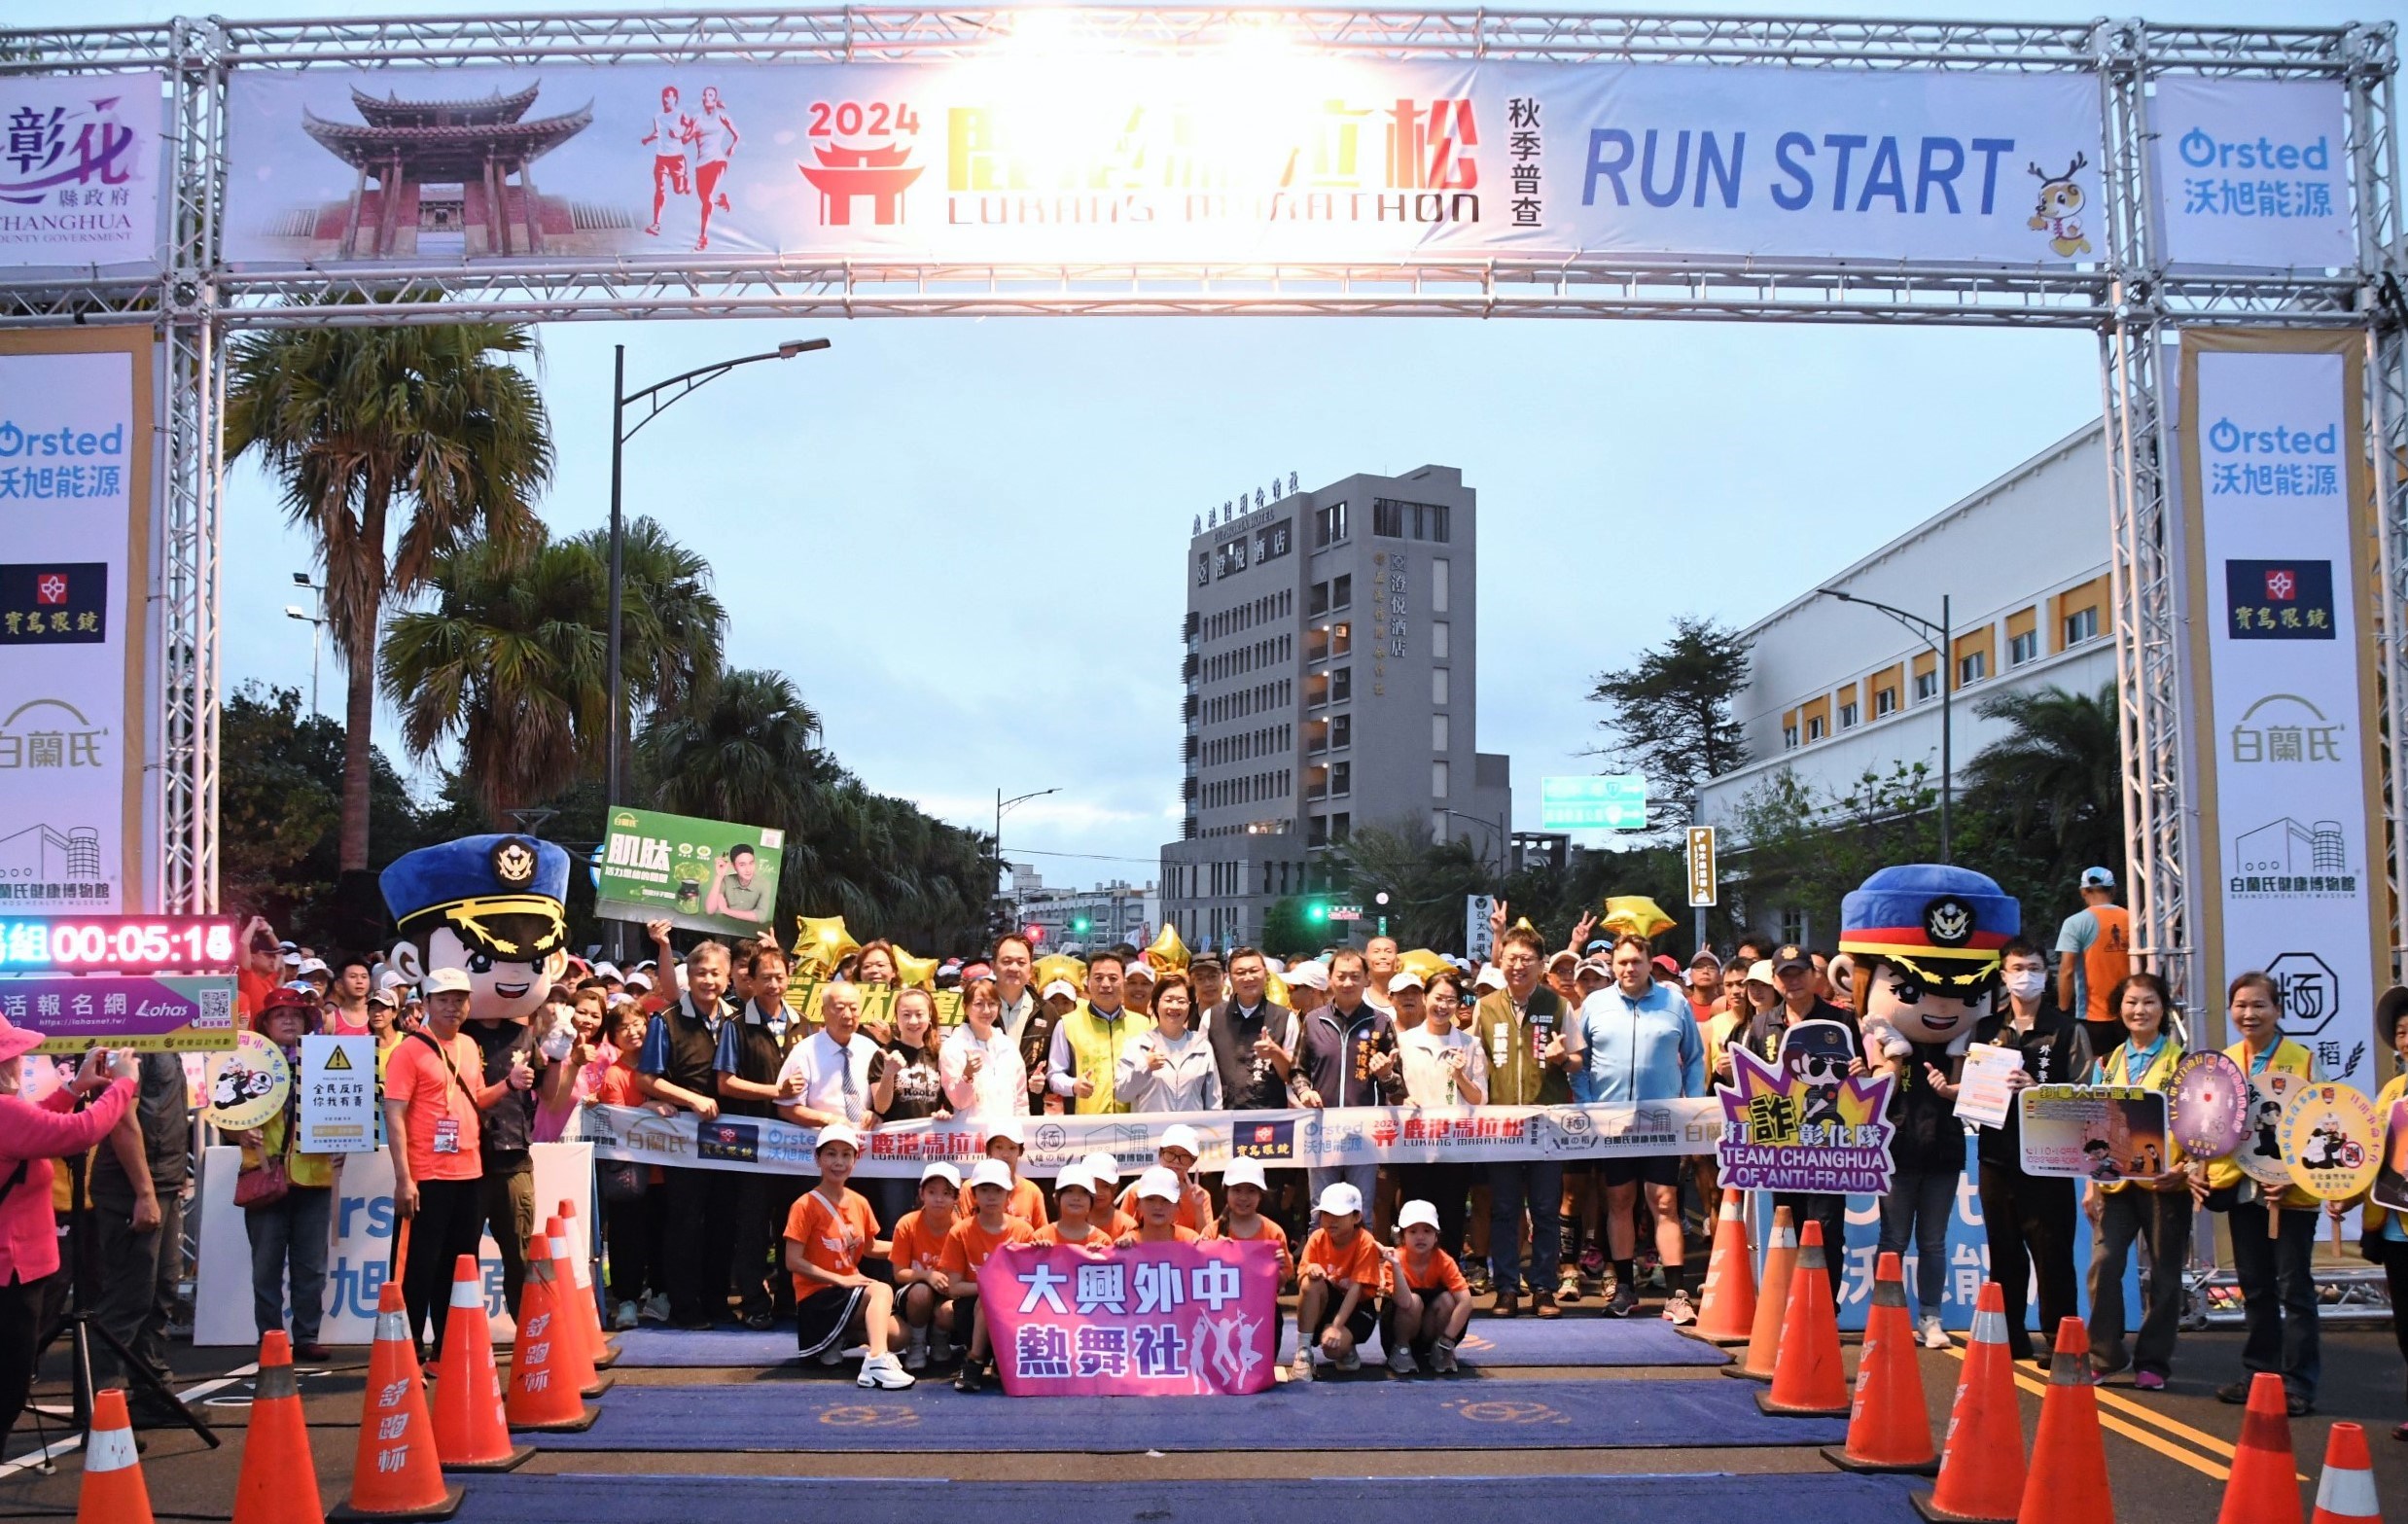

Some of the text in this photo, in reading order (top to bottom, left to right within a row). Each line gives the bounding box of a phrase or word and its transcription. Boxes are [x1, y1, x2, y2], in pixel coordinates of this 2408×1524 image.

[808, 102, 920, 136] 2024
[6, 106, 133, 185] 彰化
[1508, 96, 1542, 228] 秋季普查
[1581, 128, 2015, 216] RUN START
[59, 187, 129, 207] 縣政府
[1186, 193, 1480, 224] MRATHON
[2184, 178, 2333, 218] 沃旭能源
[0, 213, 131, 230] HANGHUA
[43, 232, 132, 243] GOVERNMENT
[0, 465, 121, 498] 沃旭能源
[2212, 463, 2338, 497] 沃旭能源
[1251, 509, 1275, 529] HOTEL
[4, 612, 99, 634] 寶島眼鏡
[2235, 606, 2329, 630] 寶島眼鏡
[0, 729, 103, 768] 白蘭氏
[2231, 725, 2341, 763] 白蘭氏
[607, 833, 673, 872] 肌肽
[2230, 876, 2355, 892] 白蘭氏健康博物館
[4, 993, 127, 1017] 活報名網
[136, 1000, 188, 1017] Lohas
[313, 1083, 363, 1094] 全民反詐
[313, 1096, 363, 1107] 你我有責
[1403, 1117, 1526, 1140] 鹿港馬拉松
[1725, 1093, 1883, 1149] 打詐彰化隊
[627, 1129, 688, 1154] 白蘭氏
[767, 1128, 816, 1147] Ørste
[1303, 1140, 1363, 1154] 沃旭能源
[1404, 1137, 1525, 1147] LUKANG MARATHON
[767, 1146, 813, 1162] 沃旭能
[1723, 1147, 1885, 1169] TEAM CHANGHUA
[1736, 1169, 1878, 1188] OF ANTI-FRAUD
[1016, 1263, 1240, 1314] 大興外中
[524, 1312, 550, 1394] 舒跑杯
[1014, 1324, 1188, 1379] 熱舞社
[378, 1379, 409, 1473] 舒跑杯
